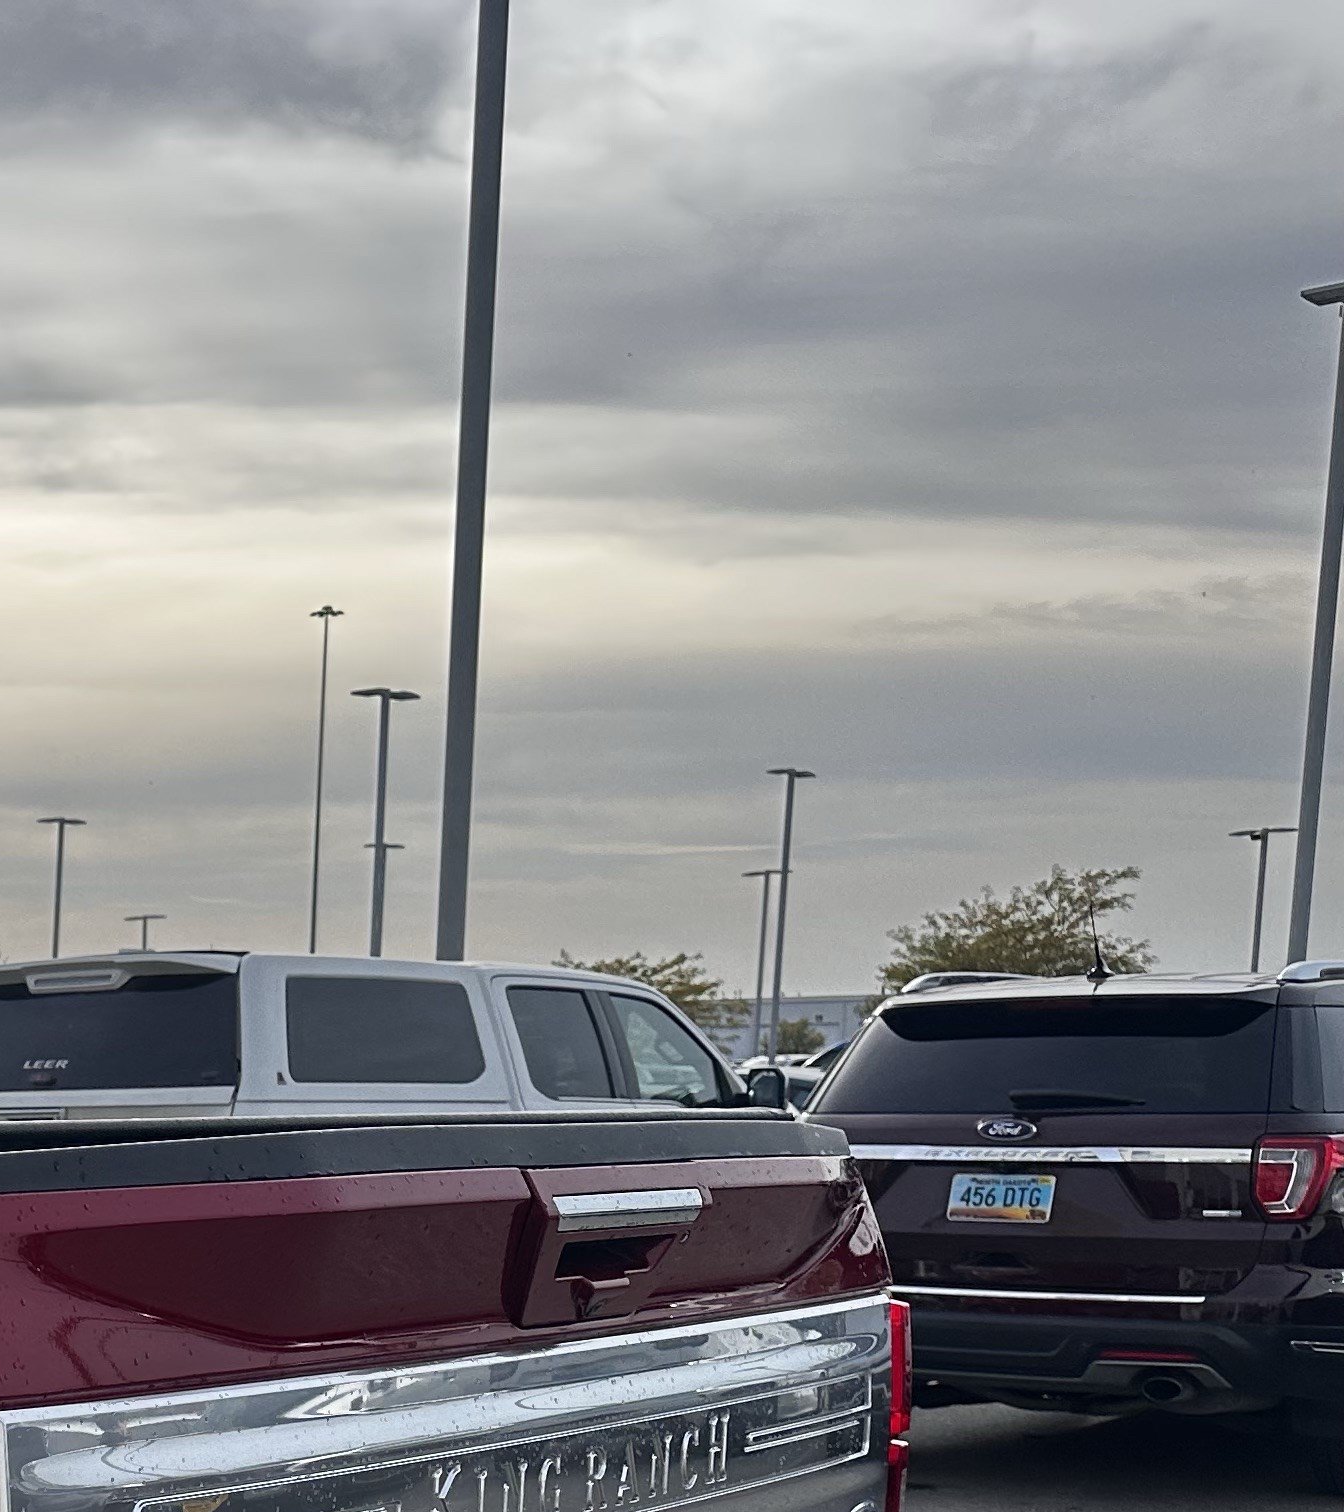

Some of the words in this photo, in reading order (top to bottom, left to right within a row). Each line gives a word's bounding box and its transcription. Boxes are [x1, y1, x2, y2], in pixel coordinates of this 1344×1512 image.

[23, 1059, 69, 1070] LEER
[960, 1186, 996, 1207] 456
[1003, 1186, 1042, 1208] DTG
